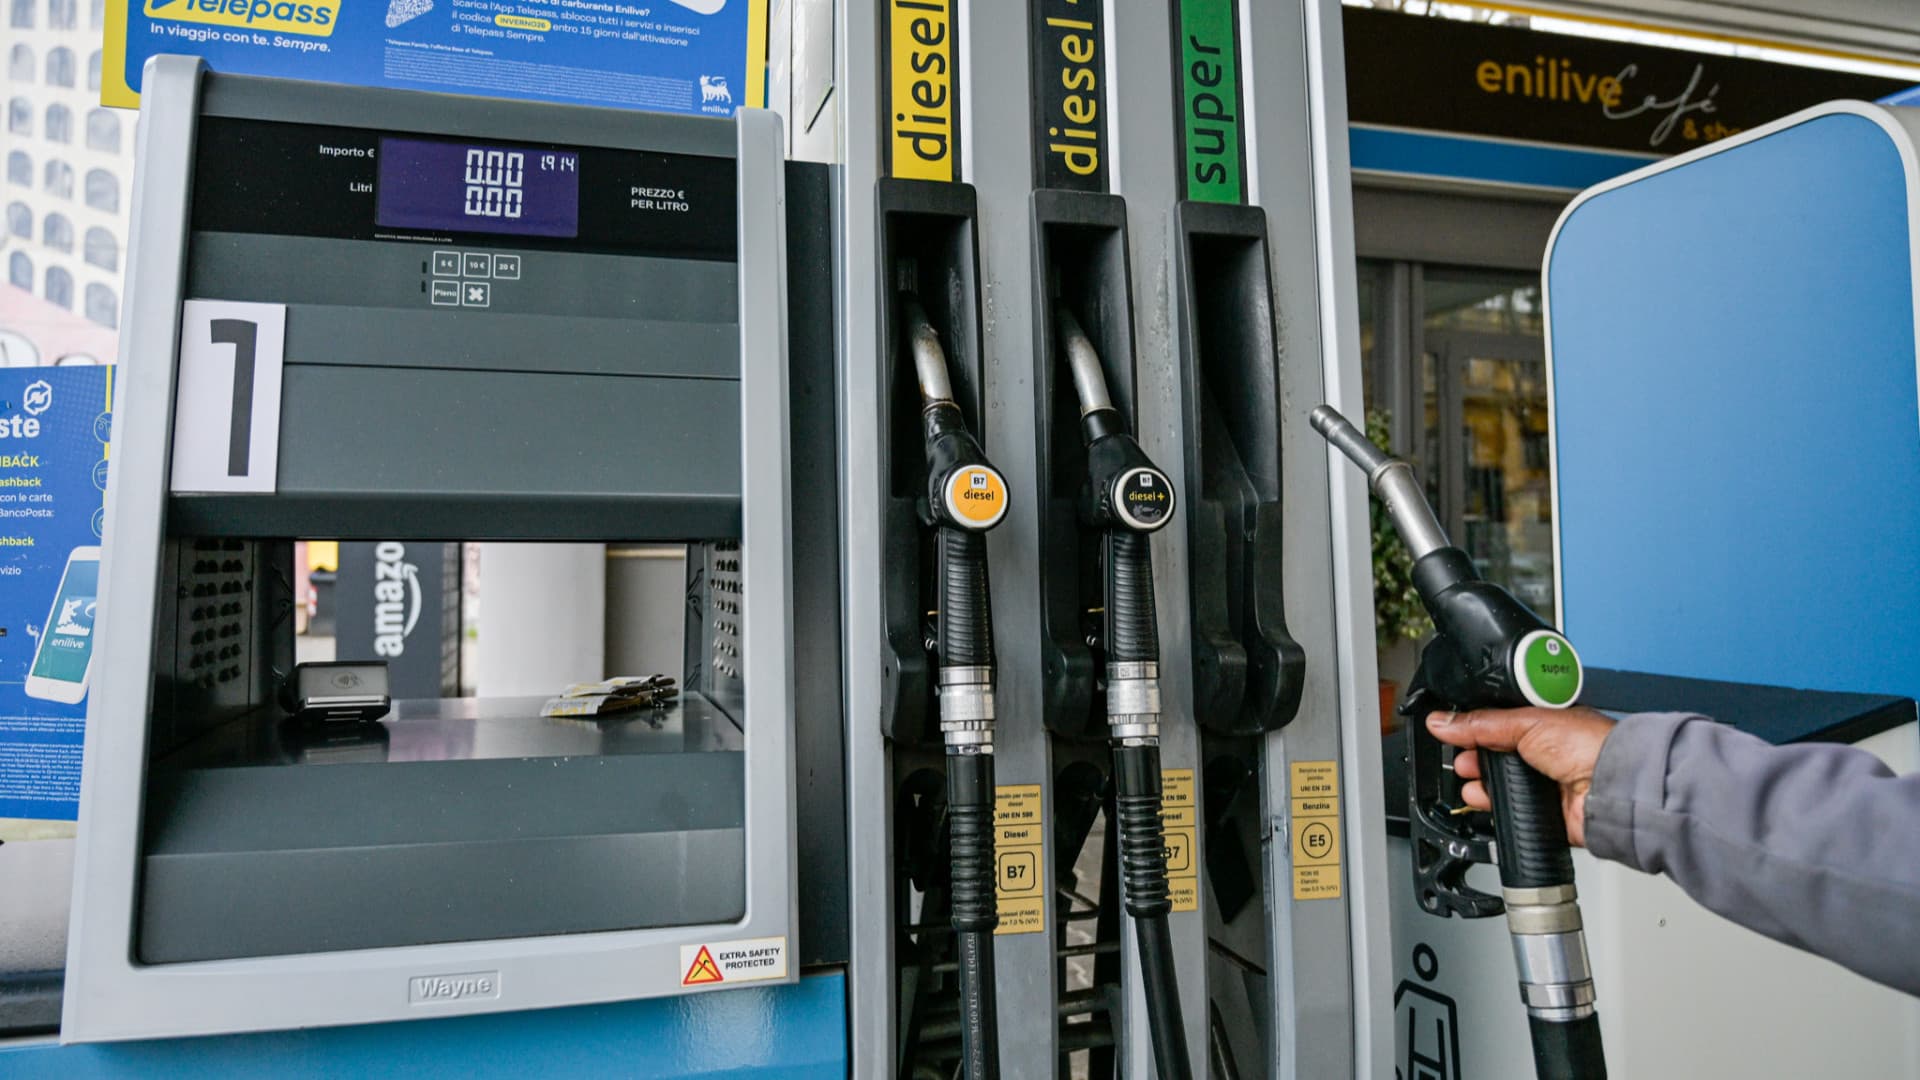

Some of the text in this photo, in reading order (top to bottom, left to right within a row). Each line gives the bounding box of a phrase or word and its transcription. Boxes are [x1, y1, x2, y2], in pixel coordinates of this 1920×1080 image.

[459, 11, 492, 23] codice
[553, 23, 578, 34] entro
[581, 26, 592, 35] 15
[594, 28, 620, 39] giorni
[622, 29, 688, 47] dall'attivazione
[561, 10, 597, 23] sblocca
[598, 15, 619, 26] tutti
[625, 19, 654, 31] servizi
[664, 23, 700, 36] inserisci
[150, 22, 331, 52] In viaggio con te. Sempre.
[451, 23, 545, 42] di Telepass Sempre.
[895, 0, 948, 161] diesel
[1476, 56, 1623, 107] enilive
[1046, 17, 1097, 175] diesel
[702, 105, 730, 114] enilive
[1189, 35, 1234, 184] super
[319, 144, 375, 158] Importo €
[465, 149, 524, 187] 0.00
[350, 181, 373, 193] Litri
[631, 186, 685, 200] PREZZO €
[464, 186, 523, 218] 0.00
[631, 199, 689, 212] PER LITRO
[210, 318, 258, 477] 1
[0, 455, 39, 468] BACK
[973, 476, 985, 485] B7
[19, 492, 27, 502] le
[29, 493, 53, 502] carte
[963, 488, 994, 501] diesel
[1128, 490, 1156, 502] diesel
[374, 541, 405, 657] amazo
[51, 638, 85, 649] enilive
[1541, 663, 1571, 675] super
[1302, 802, 1330, 810] Benzina
[1004, 830, 1028, 839] Diesel
[1309, 834, 1326, 847] E5
[1007, 864, 1026, 878] B7
[719, 946, 780, 961] EXTRA SAFETY
[725, 957, 775, 970] PROTECTED
[418, 977, 492, 999] Wayne
